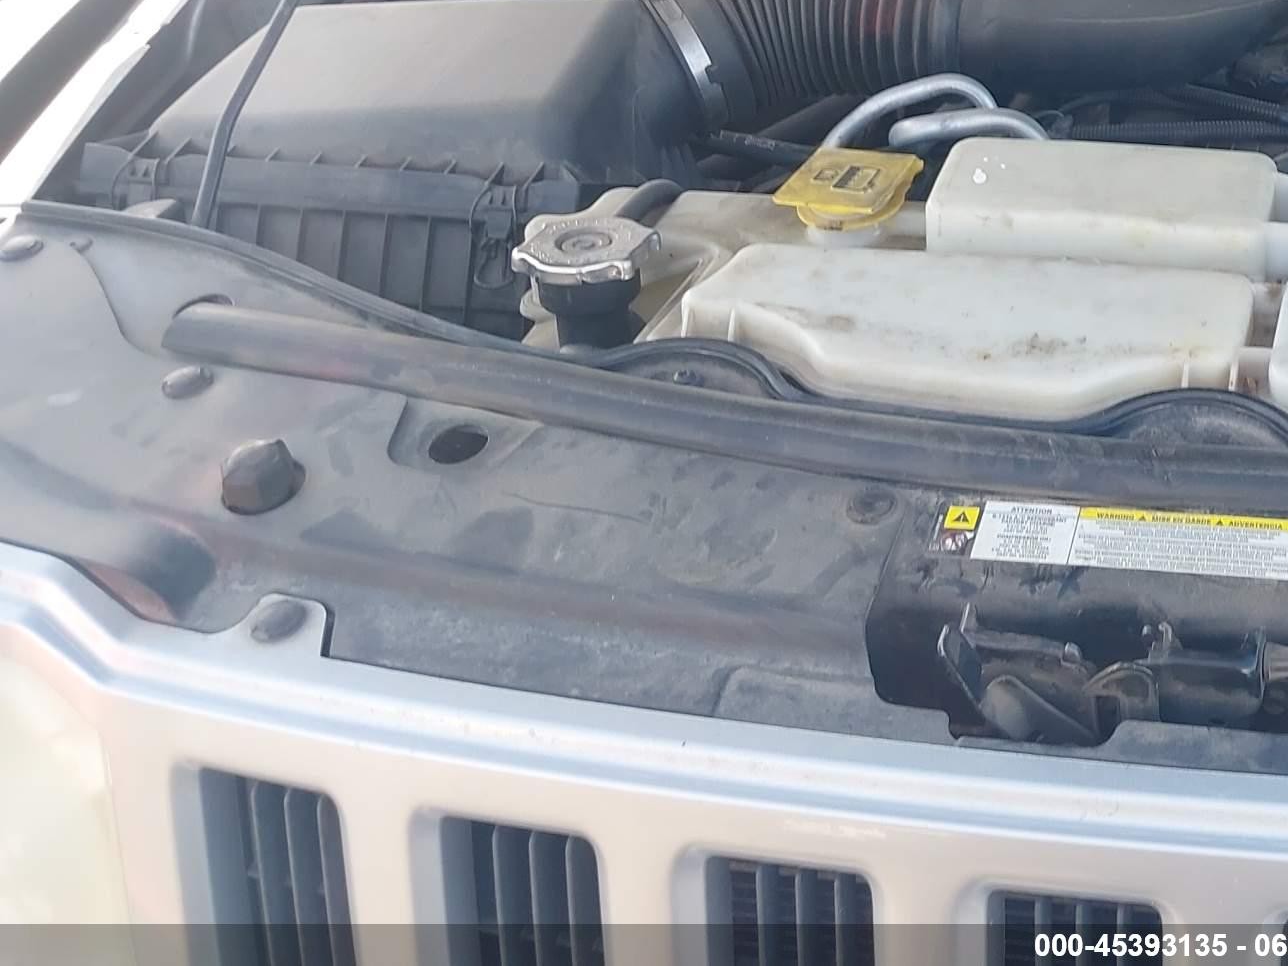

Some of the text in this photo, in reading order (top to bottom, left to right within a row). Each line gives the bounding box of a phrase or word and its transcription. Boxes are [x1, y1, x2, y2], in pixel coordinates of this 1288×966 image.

[1010, 506, 1053, 515] ATTENTION
[1096, 512, 1135, 522] WARNING
[1228, 519, 1283, 531] ADVERTENCIA
